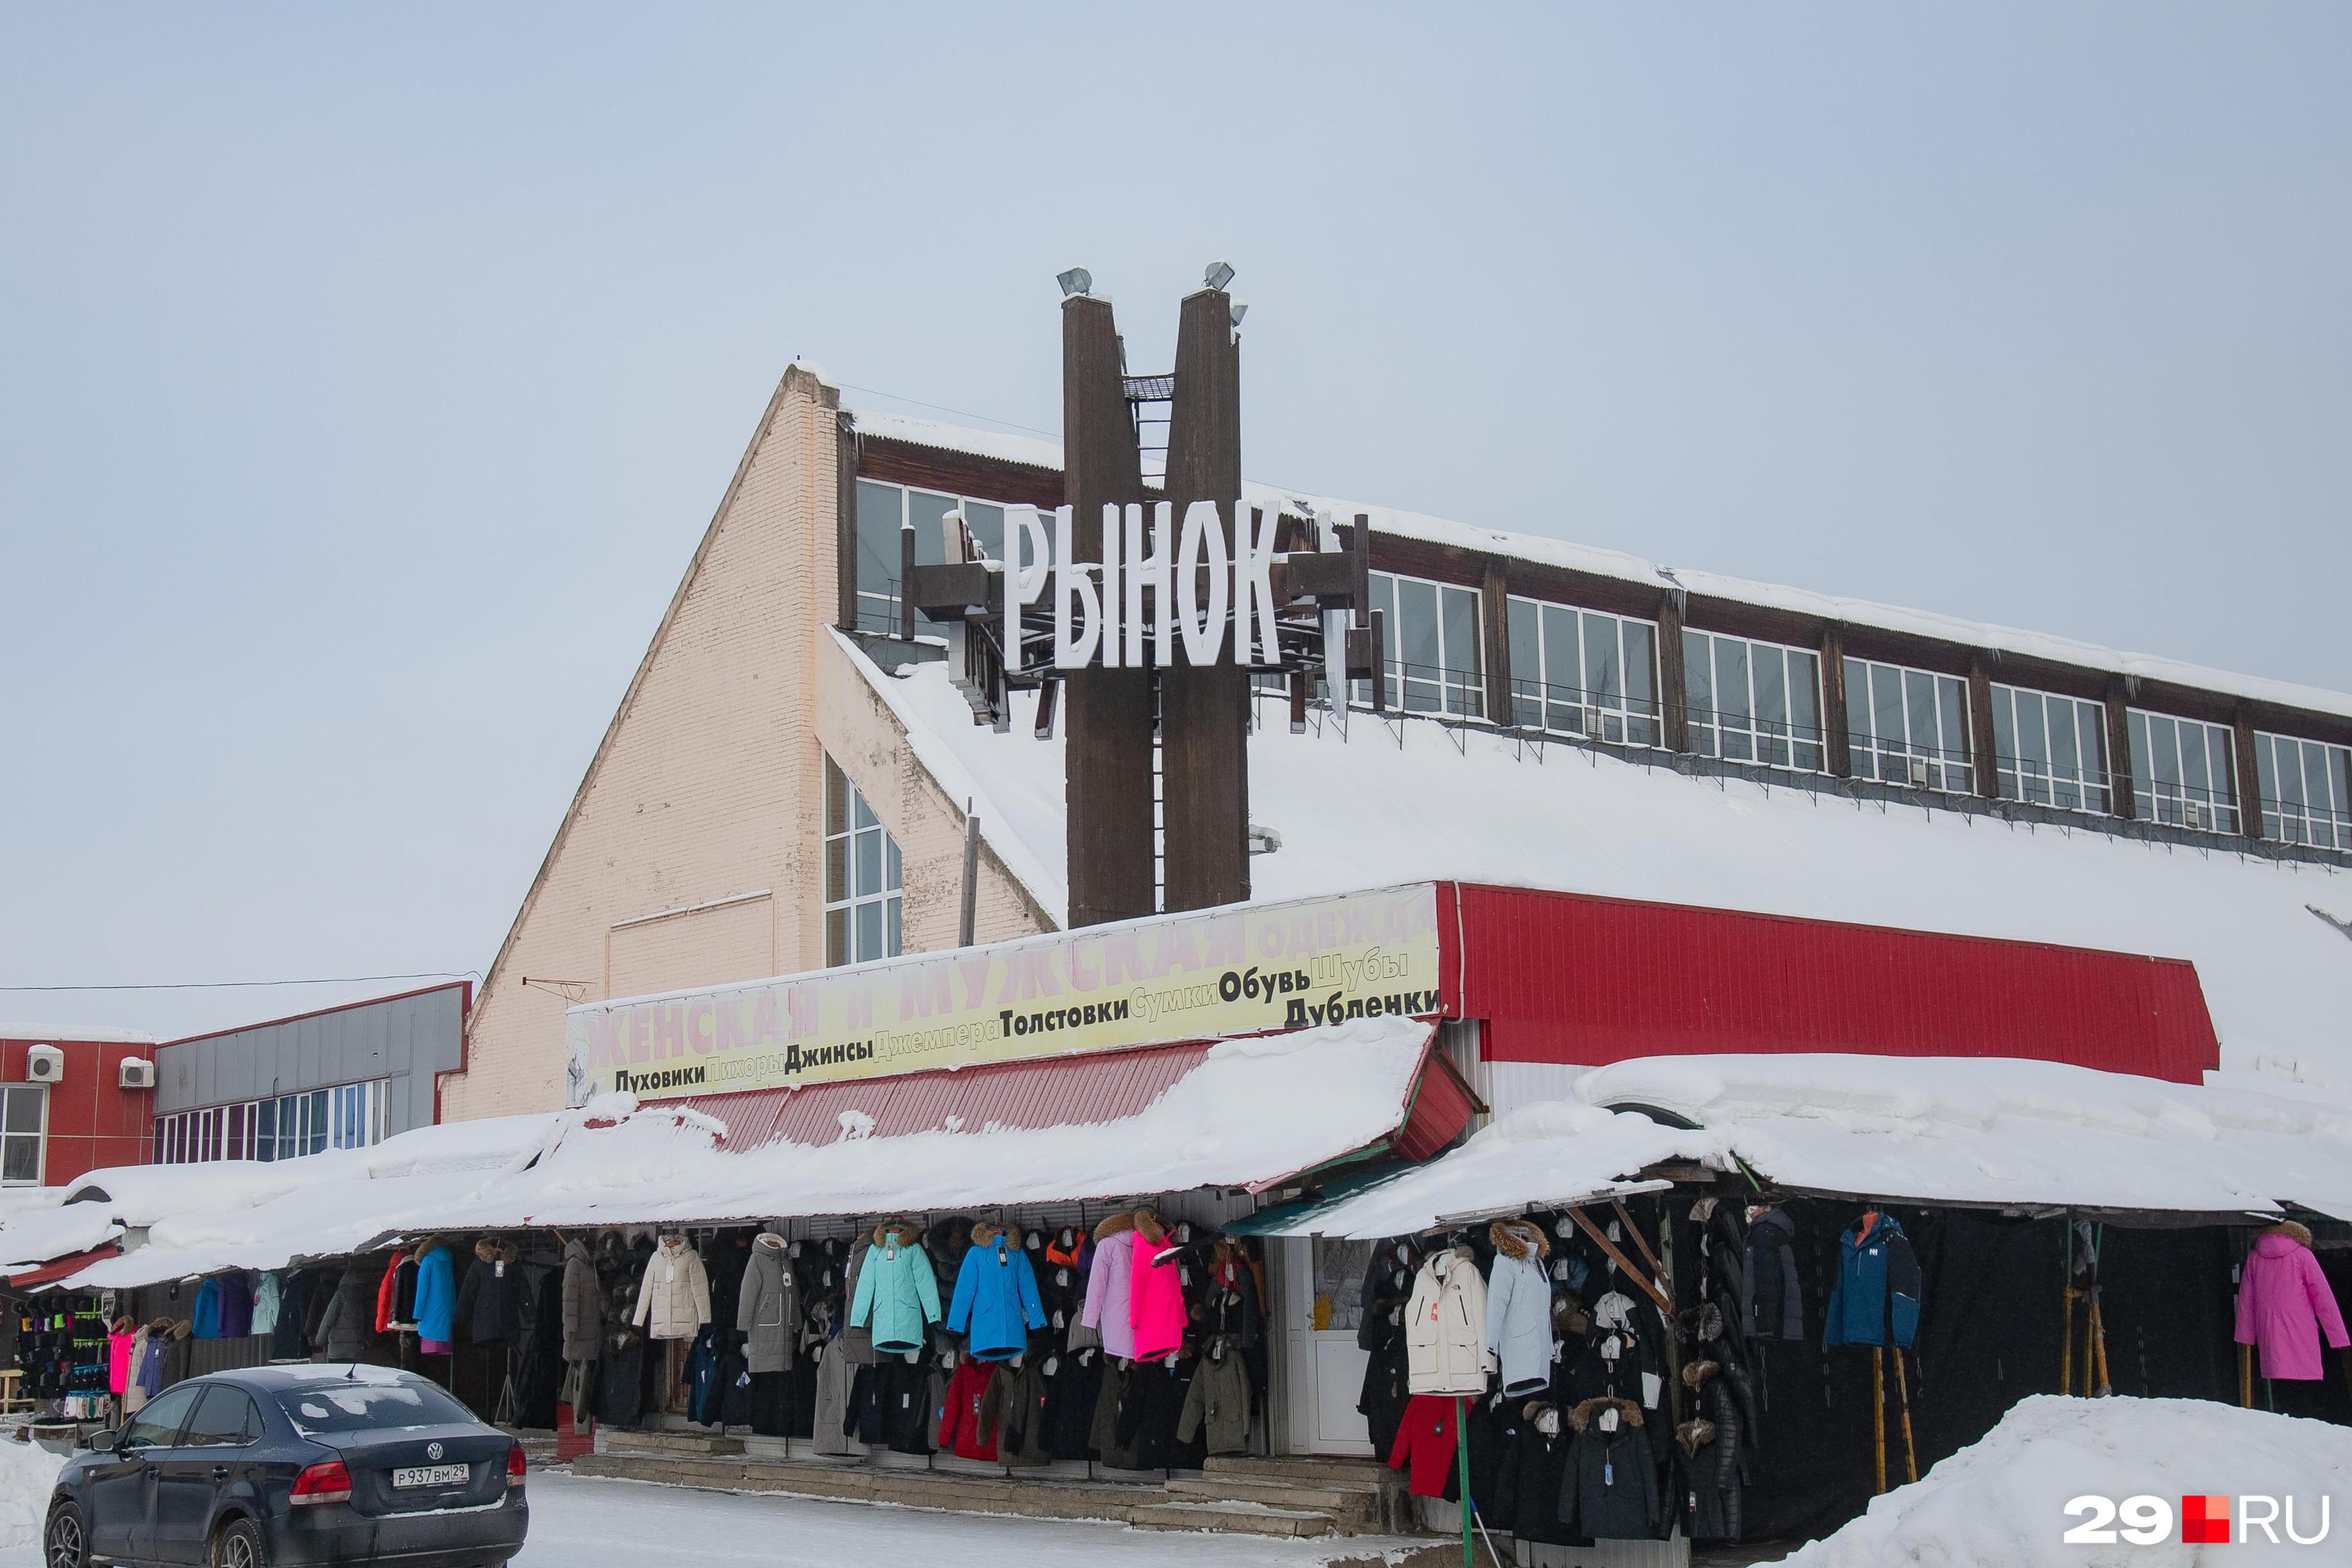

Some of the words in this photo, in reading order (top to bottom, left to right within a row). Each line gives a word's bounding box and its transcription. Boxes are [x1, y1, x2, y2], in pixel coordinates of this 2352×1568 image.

[1004, 500, 1281, 671] РЫНОК
[585, 987, 819, 1069] ЖЕНСКАЯ
[899, 917, 1245, 1022] МУЖСКАЯ
[616, 1065, 706, 1094] Пуховики
[706, 1053, 785, 1082] Пихоры
[784, 1040, 873, 1075] Джинсы
[873, 1017, 1000, 1063] Джемпера
[999, 998, 1129, 1038] Толстовки
[1129, 982, 1217, 1023] Сумки
[1218, 966, 1310, 1004] Обувь
[1310, 947, 1408, 992] Шубы
[1284, 989, 1440, 1029] Дубленки
[453, 1466, 465, 1477] 29
